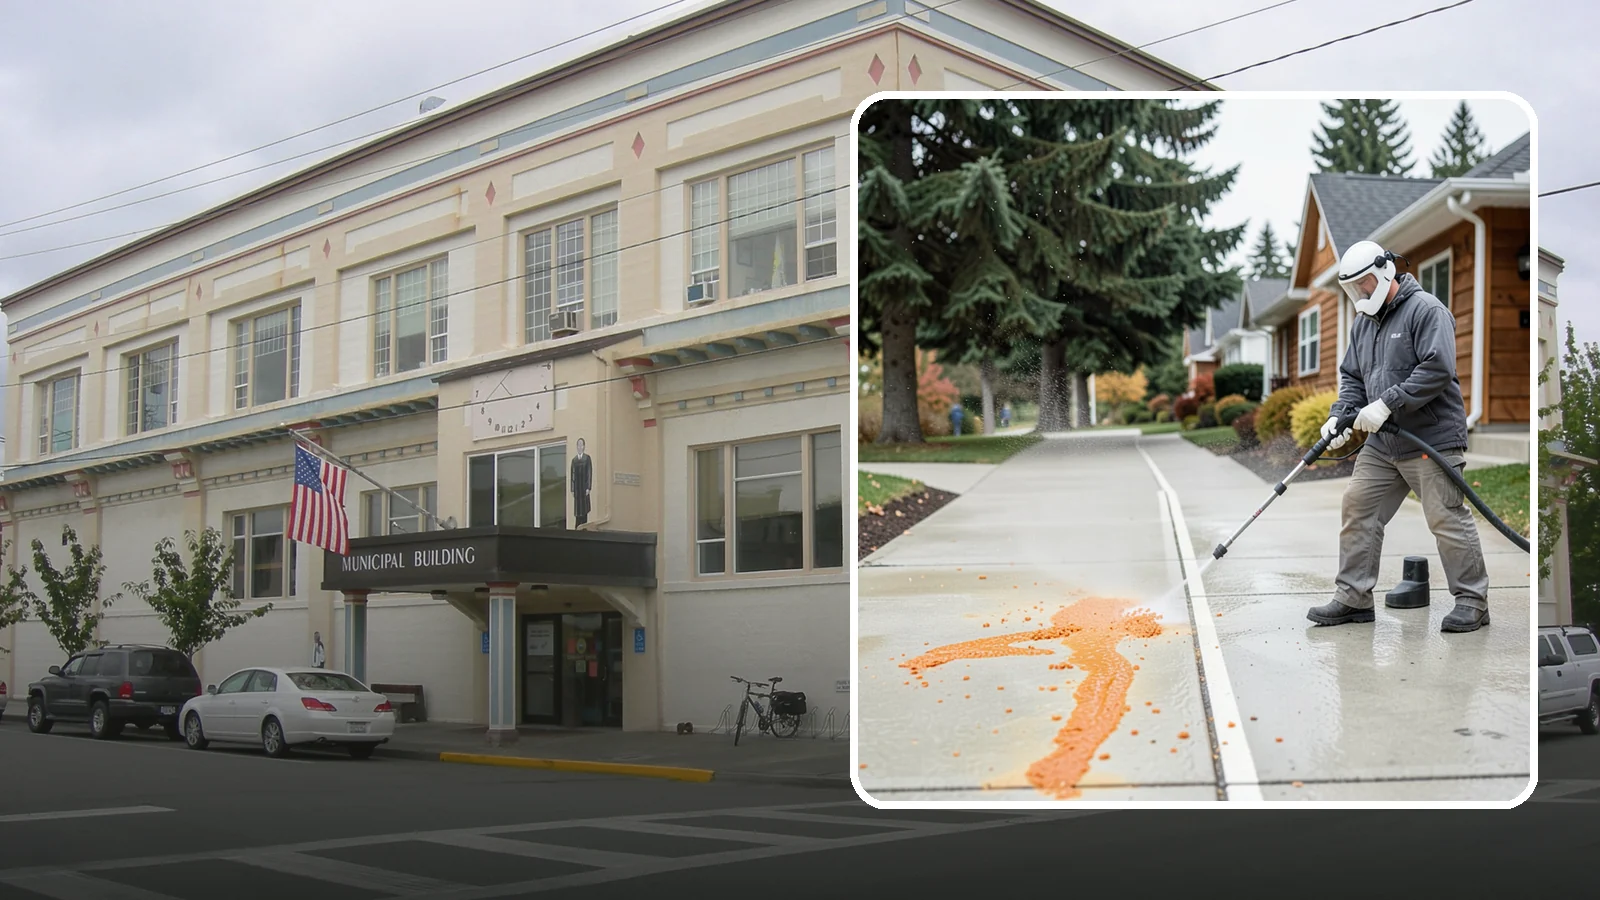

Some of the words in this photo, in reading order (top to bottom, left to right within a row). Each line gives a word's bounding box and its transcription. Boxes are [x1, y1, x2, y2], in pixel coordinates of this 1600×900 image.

[547, 362, 552, 370] 6
[475, 390, 479, 398] 7
[536, 402, 540, 410] 4
[480, 407, 485, 415] 8
[487, 417, 492, 426] 9
[529, 414, 533, 422] 3
[507, 425, 513, 433] 12
[521, 420, 526, 428] 2
[342, 552, 405, 572] MUNICIPAL
[414, 546, 475, 567] BUILDING
